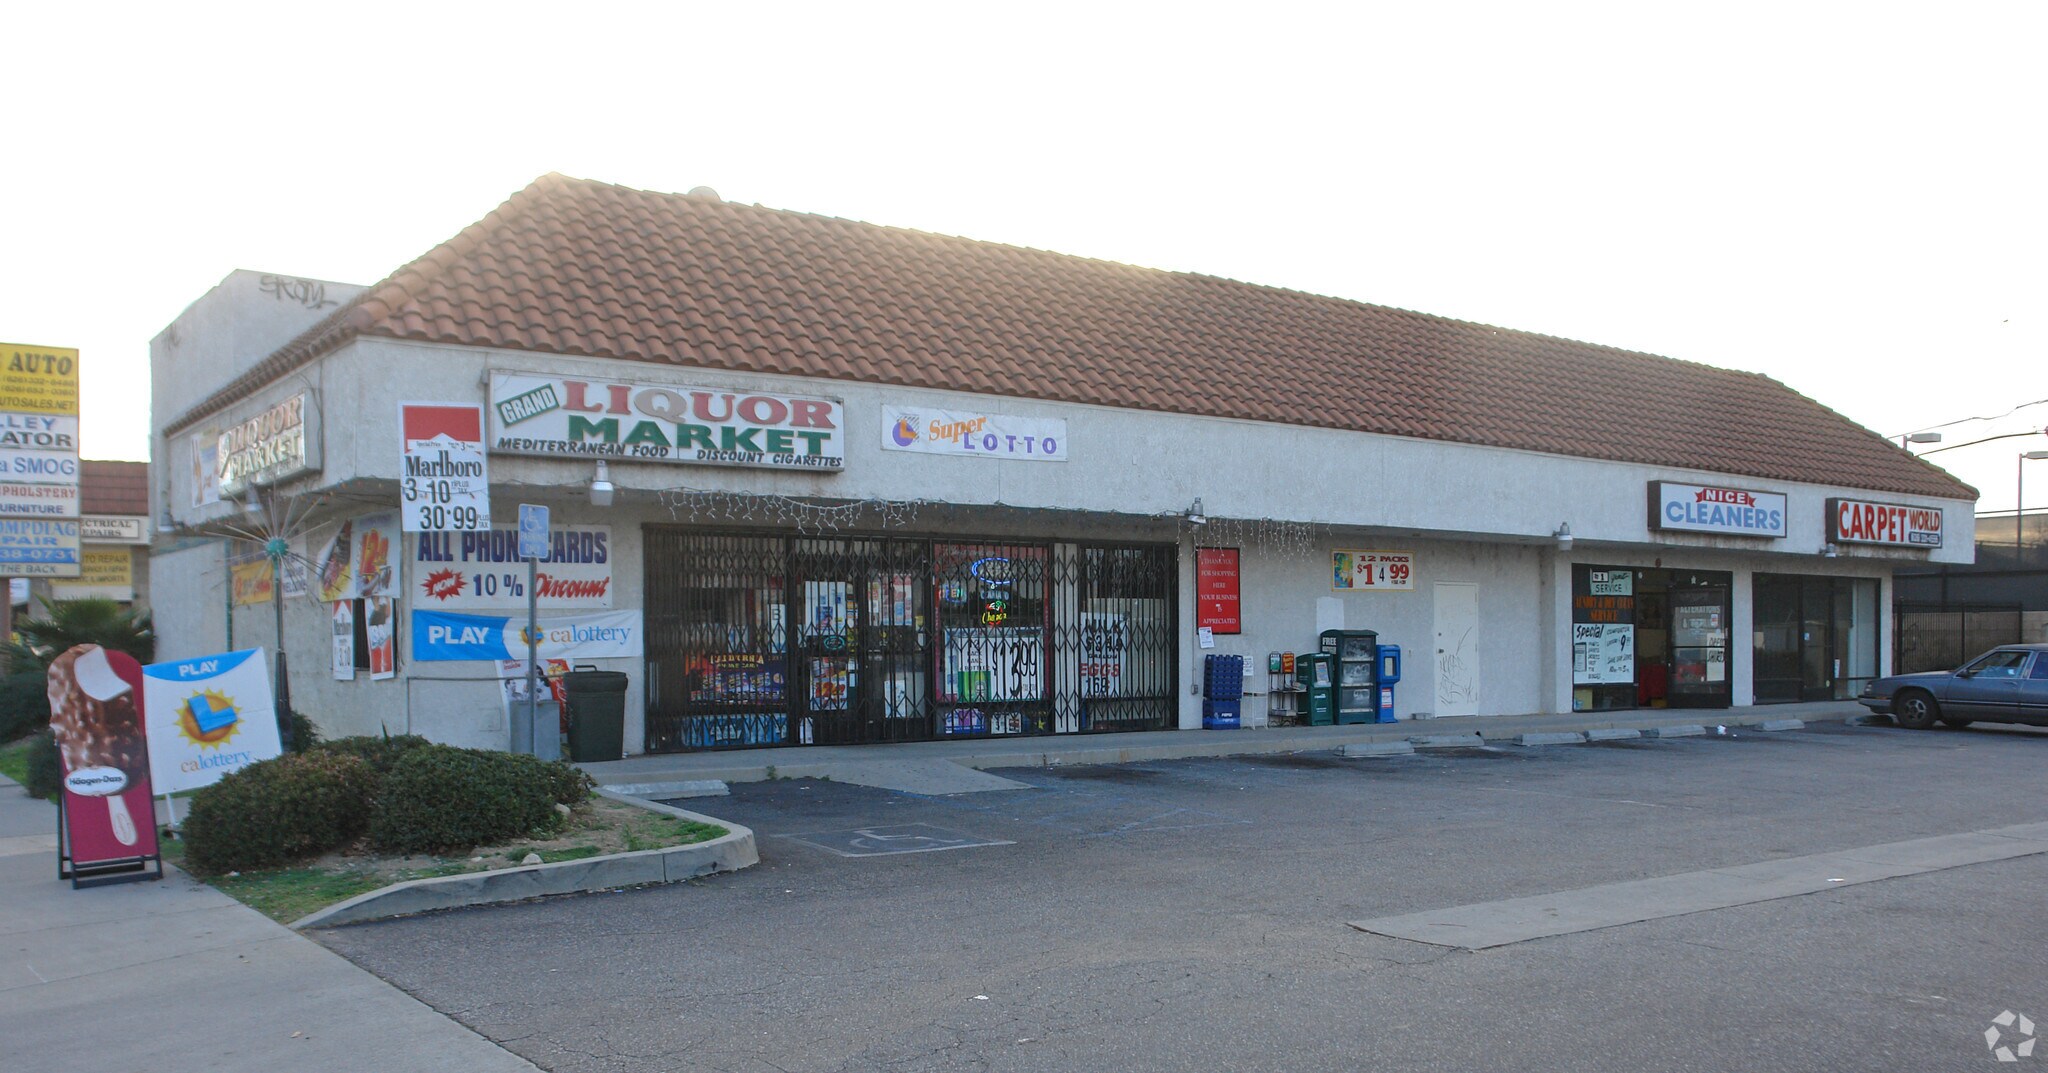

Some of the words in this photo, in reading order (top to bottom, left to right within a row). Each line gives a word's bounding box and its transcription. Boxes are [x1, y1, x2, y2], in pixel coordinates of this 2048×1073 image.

[8, 351, 73, 375] AUTO
[500, 386, 557, 424] GRAND
[562, 380, 836, 428] LIQUOR
[231, 398, 302, 454] LIQUOR
[568, 415, 831, 456] MARKET
[929, 416, 987, 443] Super
[498, 437, 626, 456] MEDITERRANEAN
[632, 445, 669, 458] FOOD
[697, 449, 764, 464] DISCOUNT
[773, 453, 842, 467] CIGARETTES
[963, 431, 1057, 455] LOTTO
[14, 457, 75, 475] SMOG
[230, 434, 301, 480] MARKET
[404, 450, 483, 477] Marlboro
[0, 486, 76, 499] PHOLSTERY
[1704, 489, 1746, 504] NICE
[1665, 500, 1781, 531] CLEANERS
[1839, 502, 1907, 542] CARPET
[1908, 508, 1940, 531] WORLD
[418, 531, 454, 562] ALL
[462, 531, 530, 563] PHON
[26, 565, 56, 574] BACK
[473, 573, 497, 597] 10
[504, 574, 524, 597] %
[535, 572, 610, 599] Discount
[1596, 584, 1622, 593] SERVICE
[428, 625, 490, 645] PLAY
[550, 624, 631, 645] calottery
[1322, 637, 1336, 646] FREE
[1576, 624, 1605, 640] Special
[178, 660, 219, 677] PLAY
[1080, 662, 1120, 677] EGGS
[180, 750, 252, 774] calottery
[69, 775, 123, 786] Häagen-Dazs
